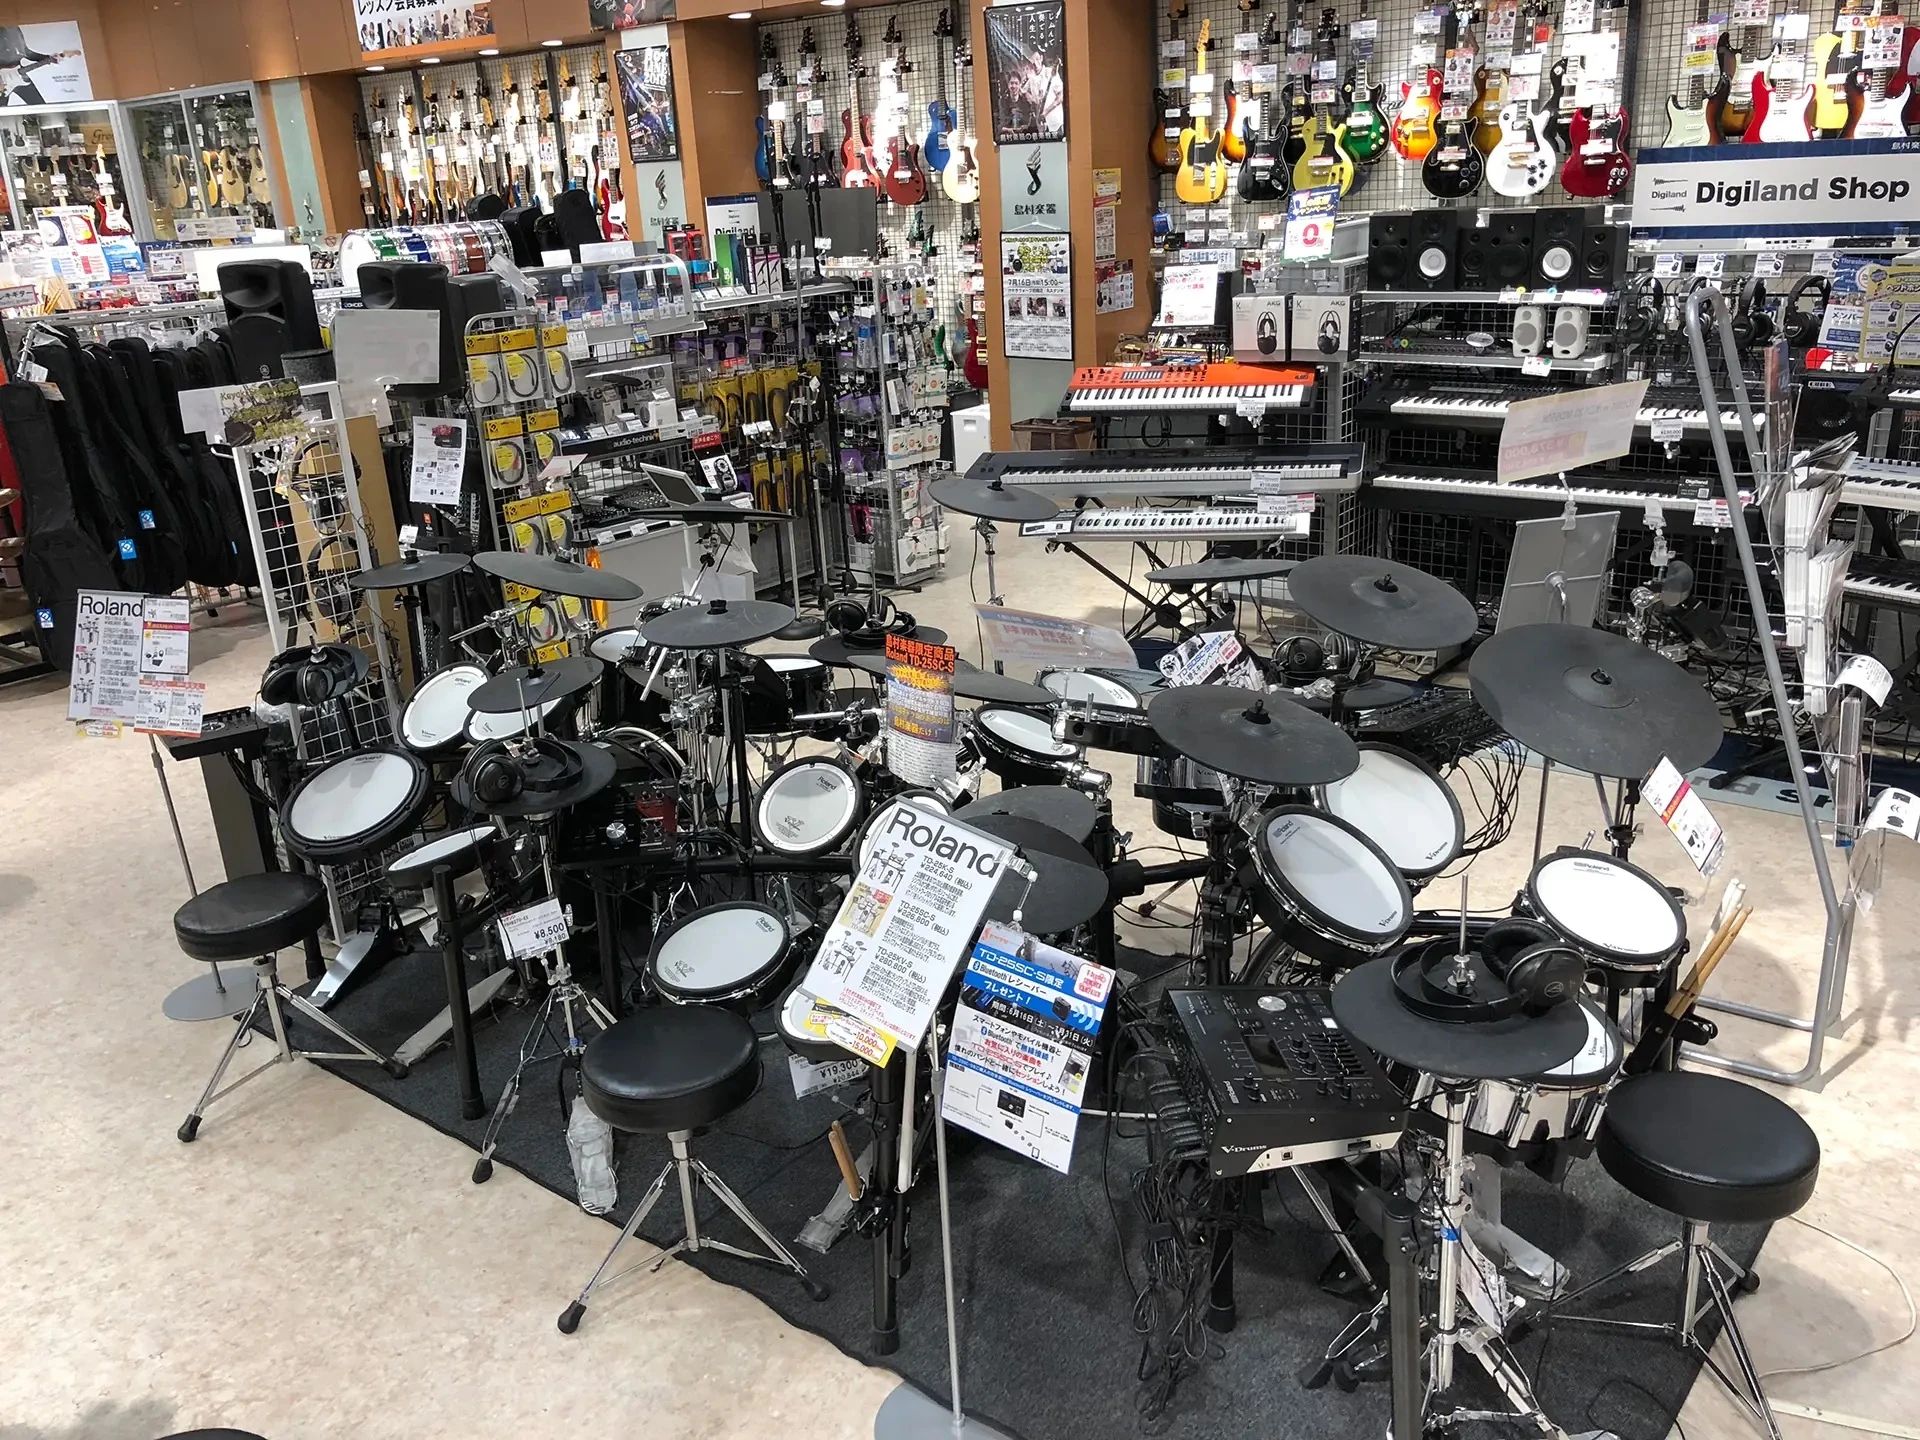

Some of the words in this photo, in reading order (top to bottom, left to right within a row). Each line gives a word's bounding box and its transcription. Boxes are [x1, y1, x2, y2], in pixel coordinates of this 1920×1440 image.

[1651, 189, 1687, 200] Digiland
[1696, 178, 1818, 207] Digiland
[1828, 176, 1910, 202] Shop
[1014, 204, 1056, 215] 島村楽器
[80, 596, 143, 617] Roland
[910, 653, 954, 673] TD-25SC-S
[817, 776, 837, 790] Roland
[887, 808, 1000, 878] Roland
[923, 855, 955, 874] TD-25K-S
[899, 900, 936, 922] TD-25SC-S
[877, 946, 913, 968] TD-25KV-S
[979, 948, 1064, 989] TD-25SC-S限定
[1221, 1143, 1267, 1154] V-Drums
